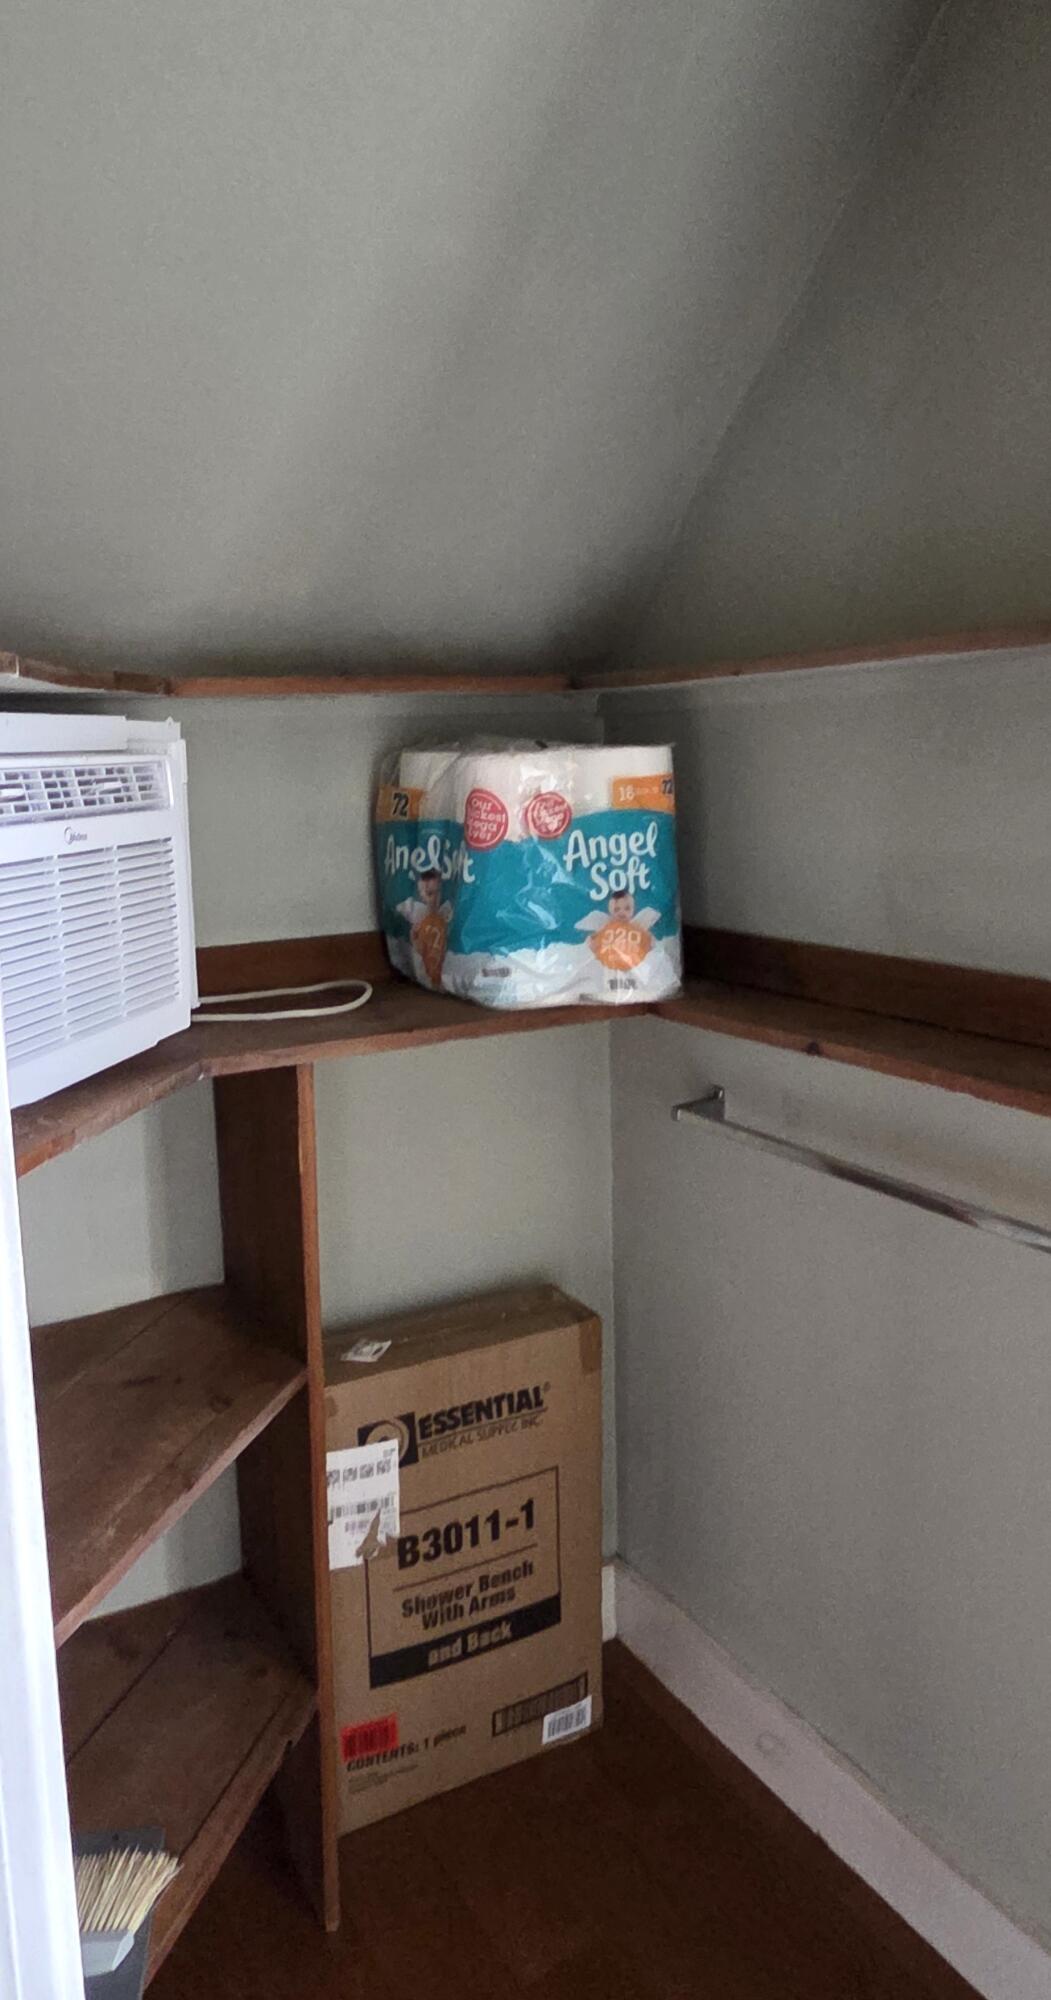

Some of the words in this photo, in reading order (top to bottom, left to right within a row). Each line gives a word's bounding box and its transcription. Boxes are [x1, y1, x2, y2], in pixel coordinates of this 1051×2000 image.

[392, 792, 409, 817] 72
[563, 822, 657, 872] Angel
[589, 857, 651, 900] Soft
[419, 1385, 544, 1440] ESSENTIAL
[421, 1433, 474, 1458] MEDICAL
[398, 1498, 534, 1570] B3011-1
[402, 1583, 473, 1618] Shower
[479, 1560, 533, 1593] Bench
[422, 1602, 464, 1630] With
[469, 1587, 516, 1616] Arms
[428, 1637, 462, 1667] and
[467, 1621, 512, 1654] Back
